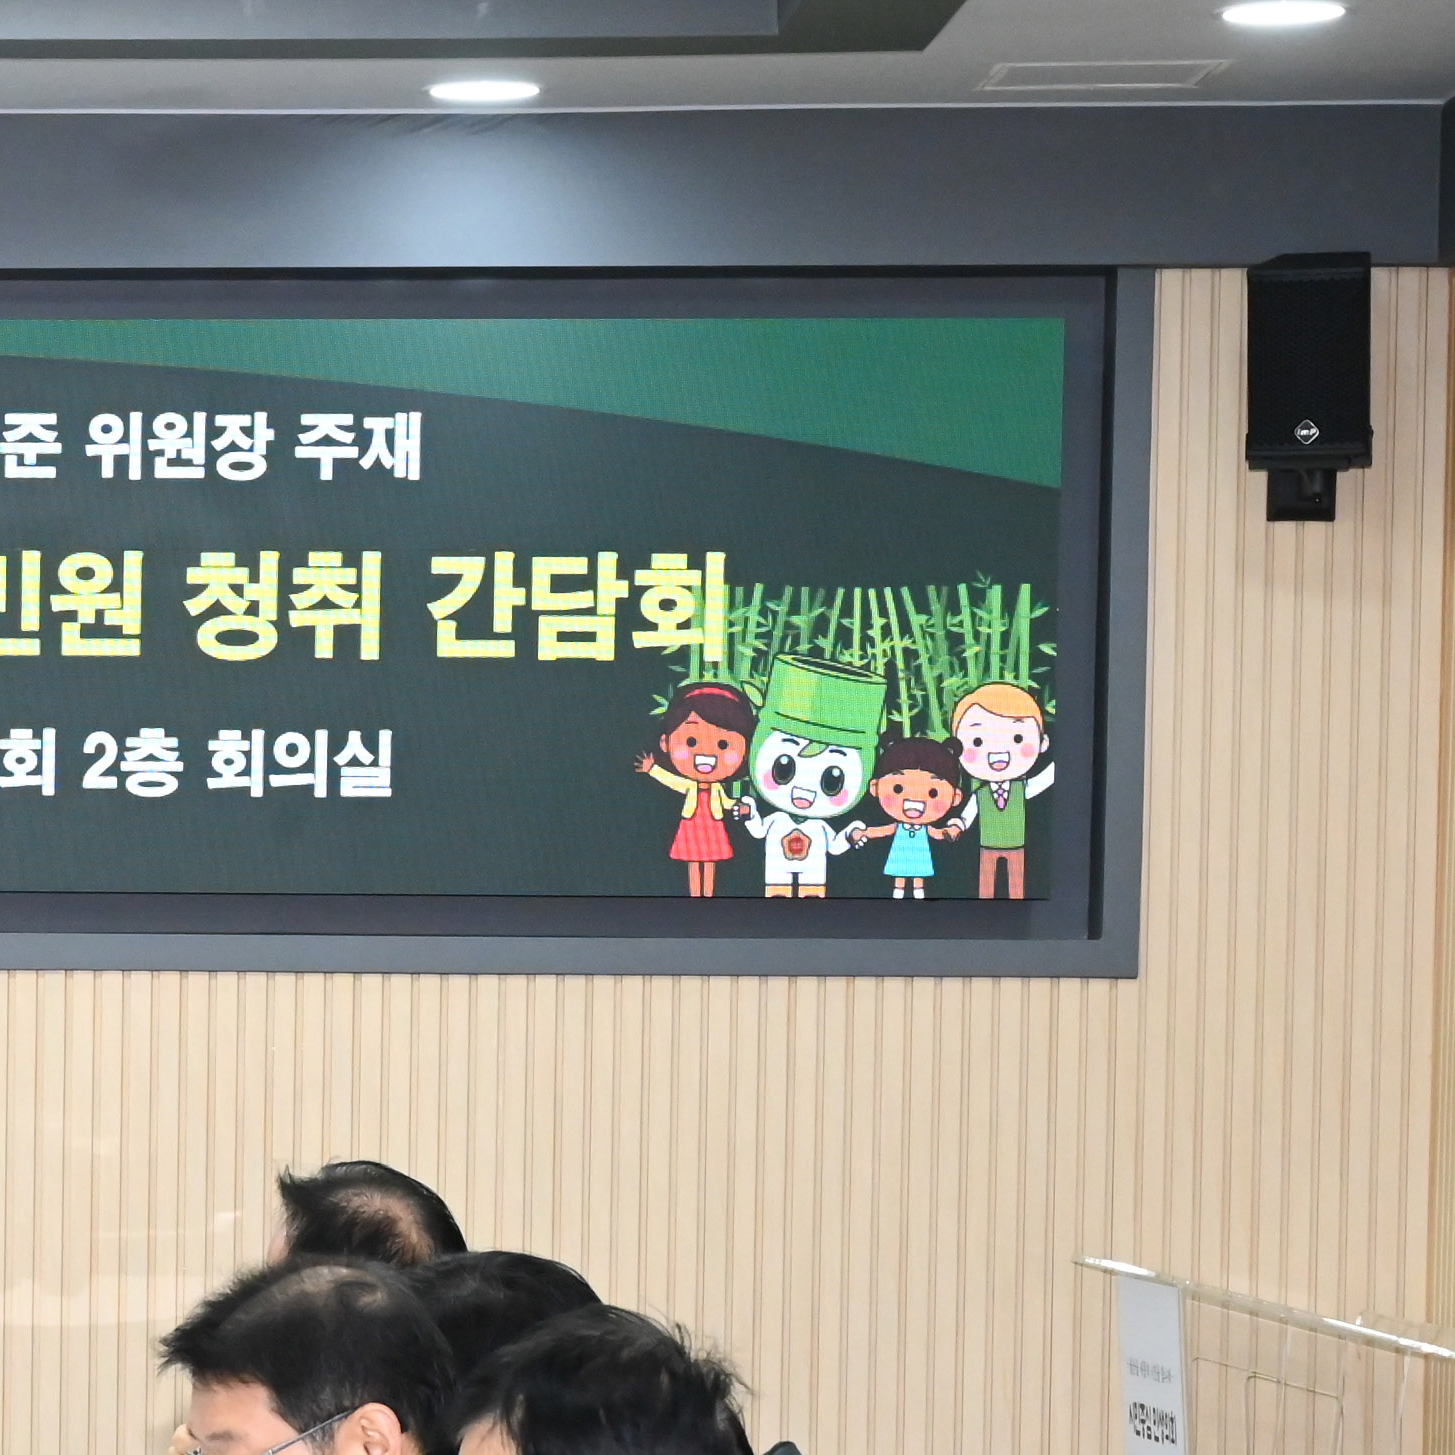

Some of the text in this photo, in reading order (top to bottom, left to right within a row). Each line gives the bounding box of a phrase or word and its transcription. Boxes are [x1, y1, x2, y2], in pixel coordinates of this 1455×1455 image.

[85, 411, 275, 482] 위원장
[295, 411, 422, 481] 주재
[183, 550, 382, 662] 청취
[427, 551, 724, 662] 간담회
[82, 727, 184, 798] 2층
[206, 728, 393, 798] 회의실
